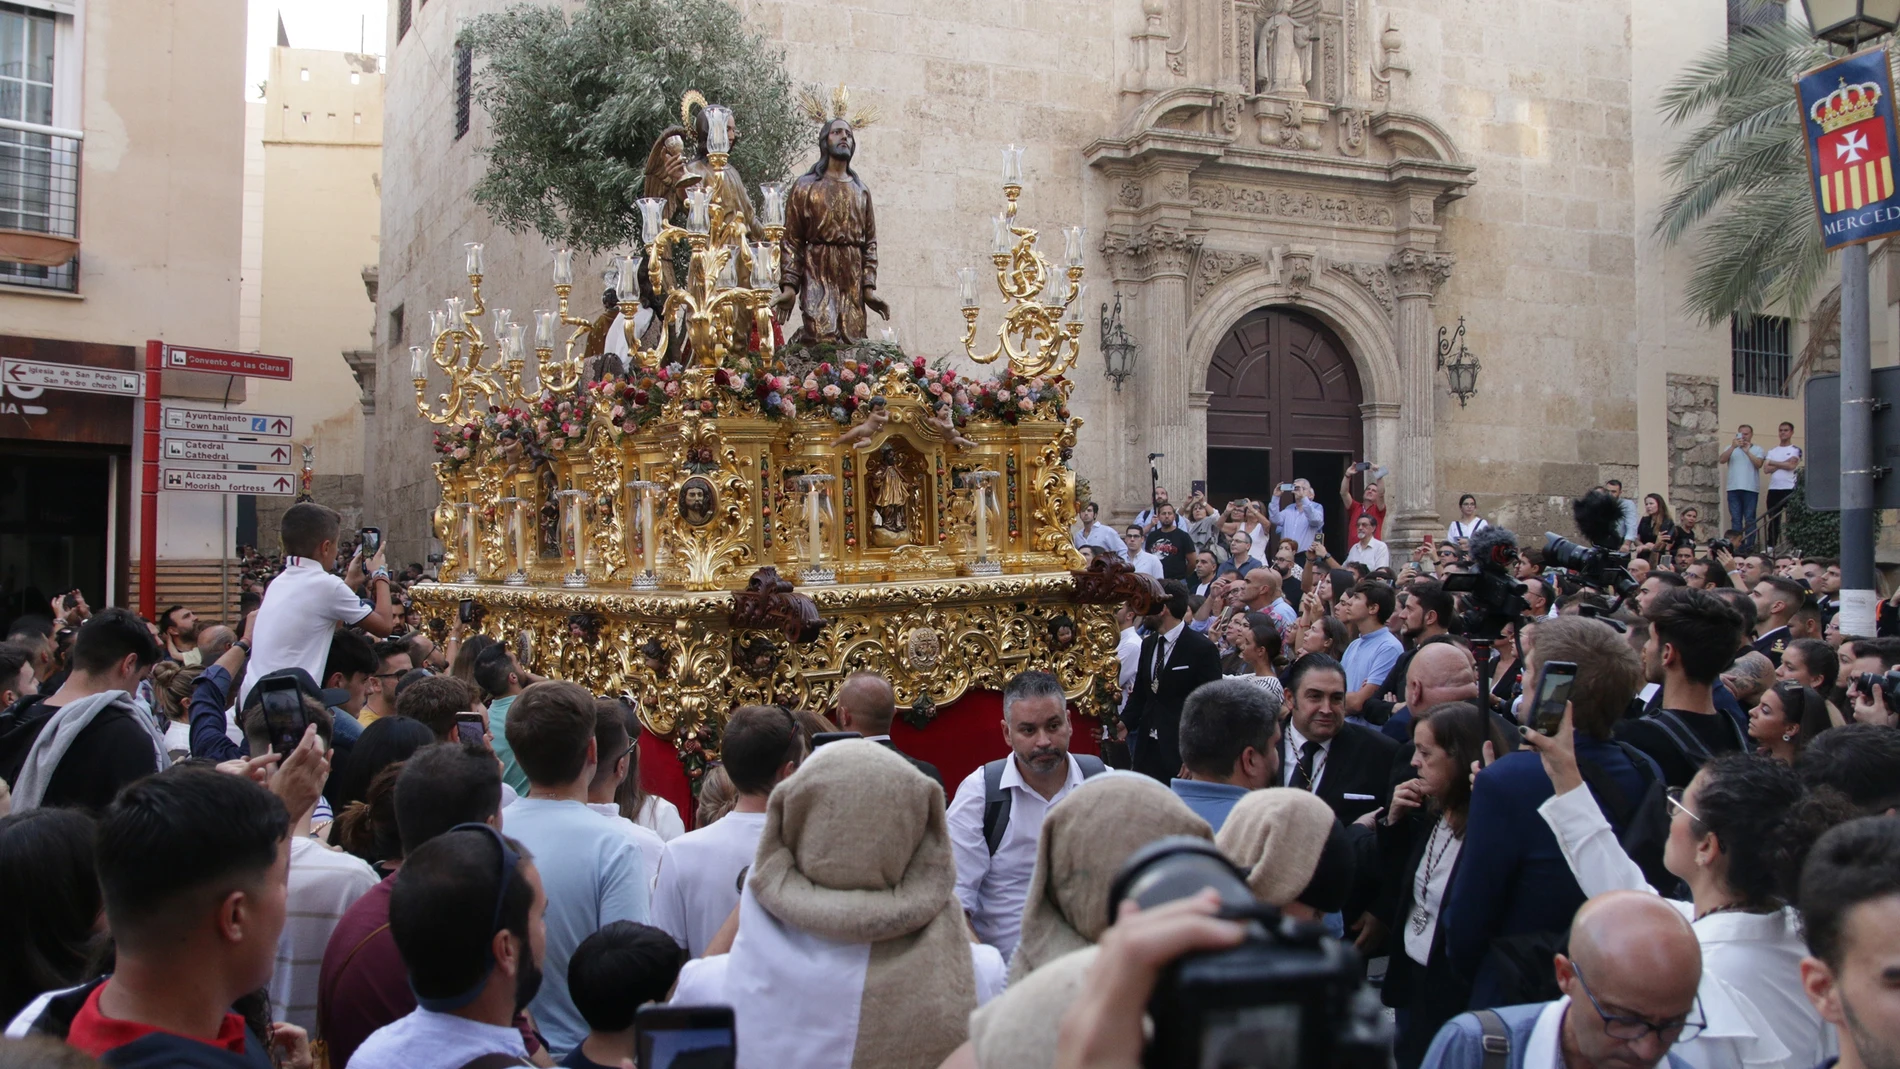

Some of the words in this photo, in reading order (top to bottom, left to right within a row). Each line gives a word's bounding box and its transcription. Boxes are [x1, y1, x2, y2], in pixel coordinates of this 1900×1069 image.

[1824, 206, 1900, 237] MERCED
[188, 355, 228, 366] Convento
[231, 360, 241, 368] de
[243, 361, 257, 370] las
[258, 362, 285, 372] Claras
[28, 366, 54, 375] Iglesia
[75, 370, 91, 379] San
[95, 373, 118, 381] Pedro
[43, 376, 59, 384] San
[64, 378, 87, 387] Pedro
[91, 382, 117, 390] church
[185, 411, 247, 423] Ayuntamiento
[185, 421, 210, 430] Town
[212, 423, 229, 431] hall
[185, 441, 225, 451] Catedral
[185, 451, 229, 460] Cathedral
[185, 471, 228, 481] Alcazaba
[185, 481, 221, 491] Moorish
[229, 483, 265, 492] fortress
